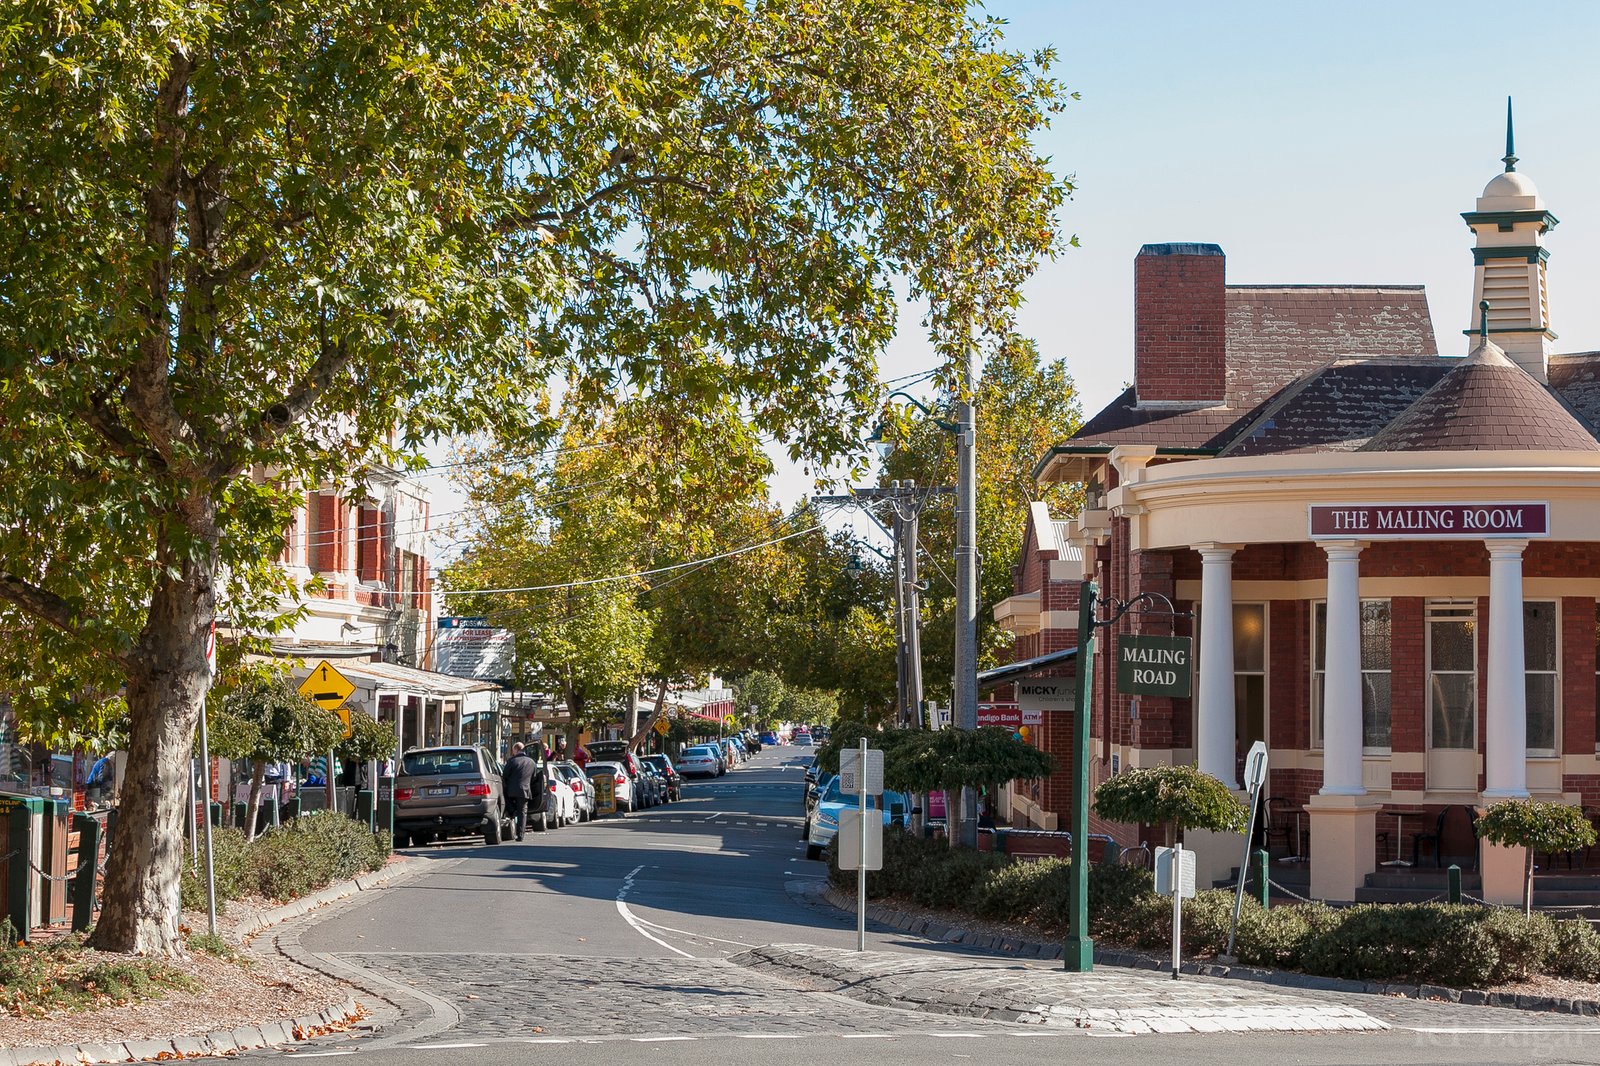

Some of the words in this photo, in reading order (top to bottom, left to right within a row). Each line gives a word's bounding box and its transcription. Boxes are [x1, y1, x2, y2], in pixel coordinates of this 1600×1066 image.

[1331, 510, 1370, 530] THE
[1376, 509, 1455, 530] MALING
[1462, 508, 1524, 529] ROOM
[1123, 647, 1186, 666] MALING
[1132, 668, 1177, 686] ROAD
[1000, 713, 1019, 722] Bank
